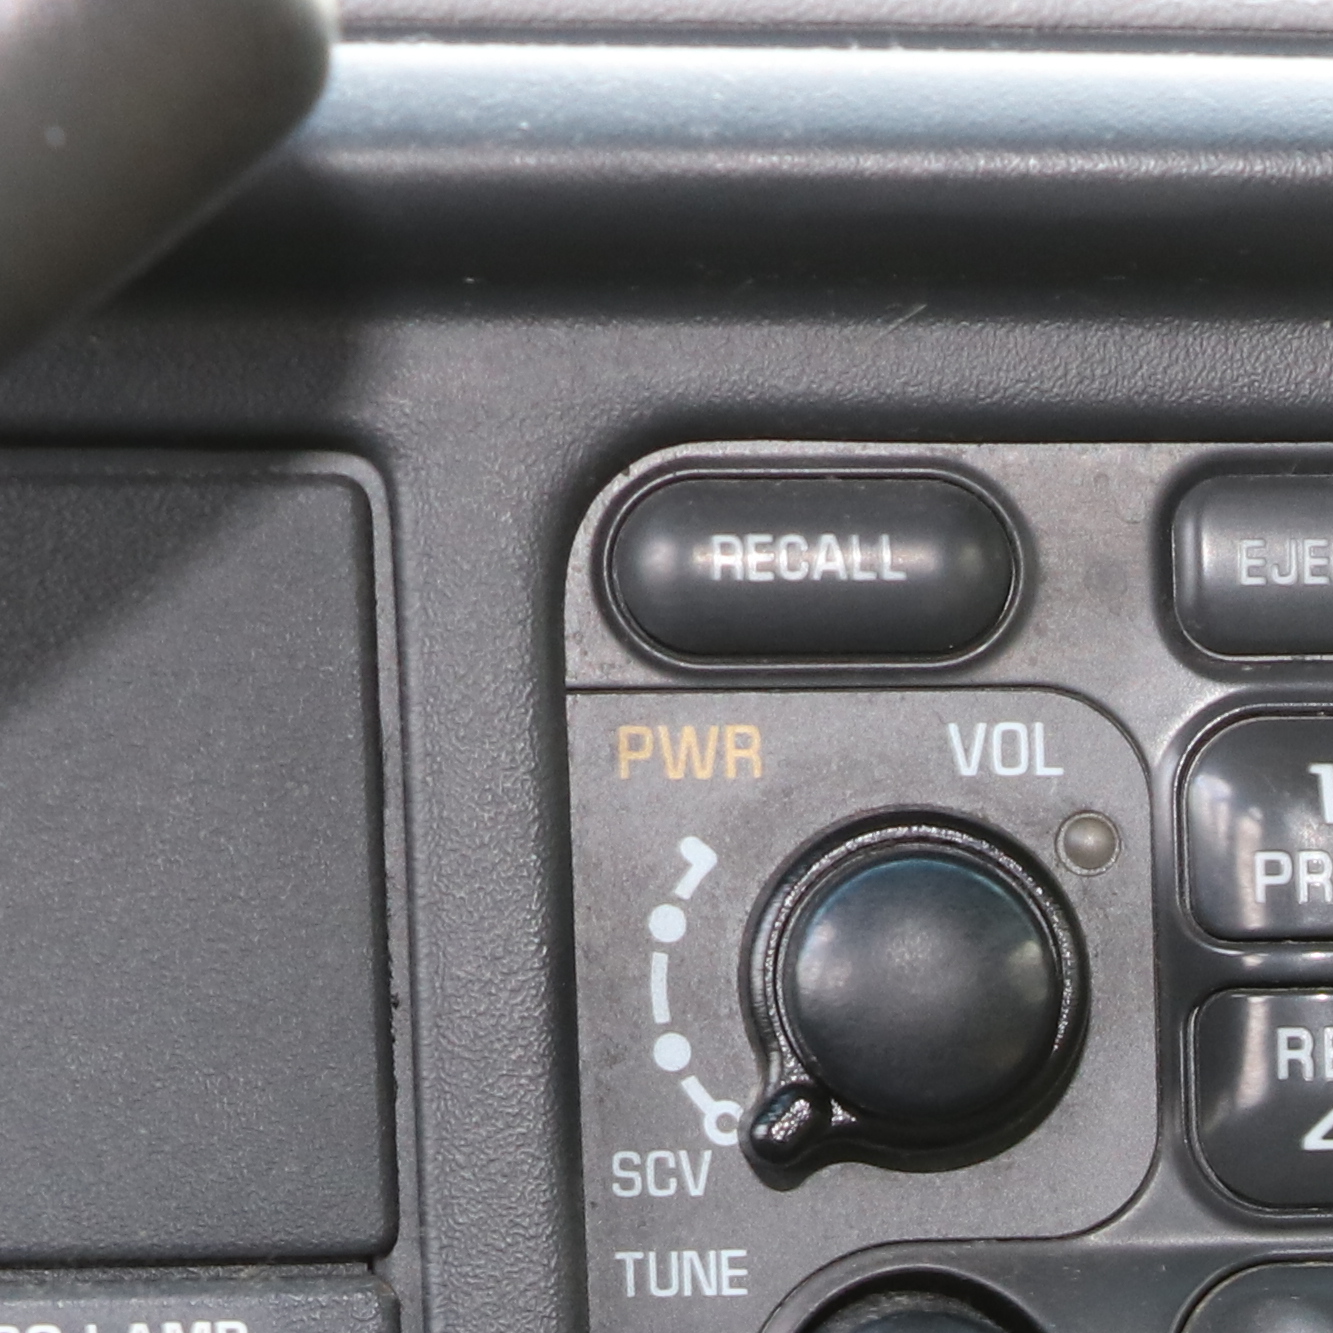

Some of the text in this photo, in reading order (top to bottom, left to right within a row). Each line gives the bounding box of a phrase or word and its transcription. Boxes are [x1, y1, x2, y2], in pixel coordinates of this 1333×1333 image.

[710, 534, 906, 582] RECALL
[616, 725, 764, 779] PWR
[947, 722, 1064, 776] VOL
[612, 1149, 712, 1197] SCV
[615, 1249, 749, 1298] TUNE
